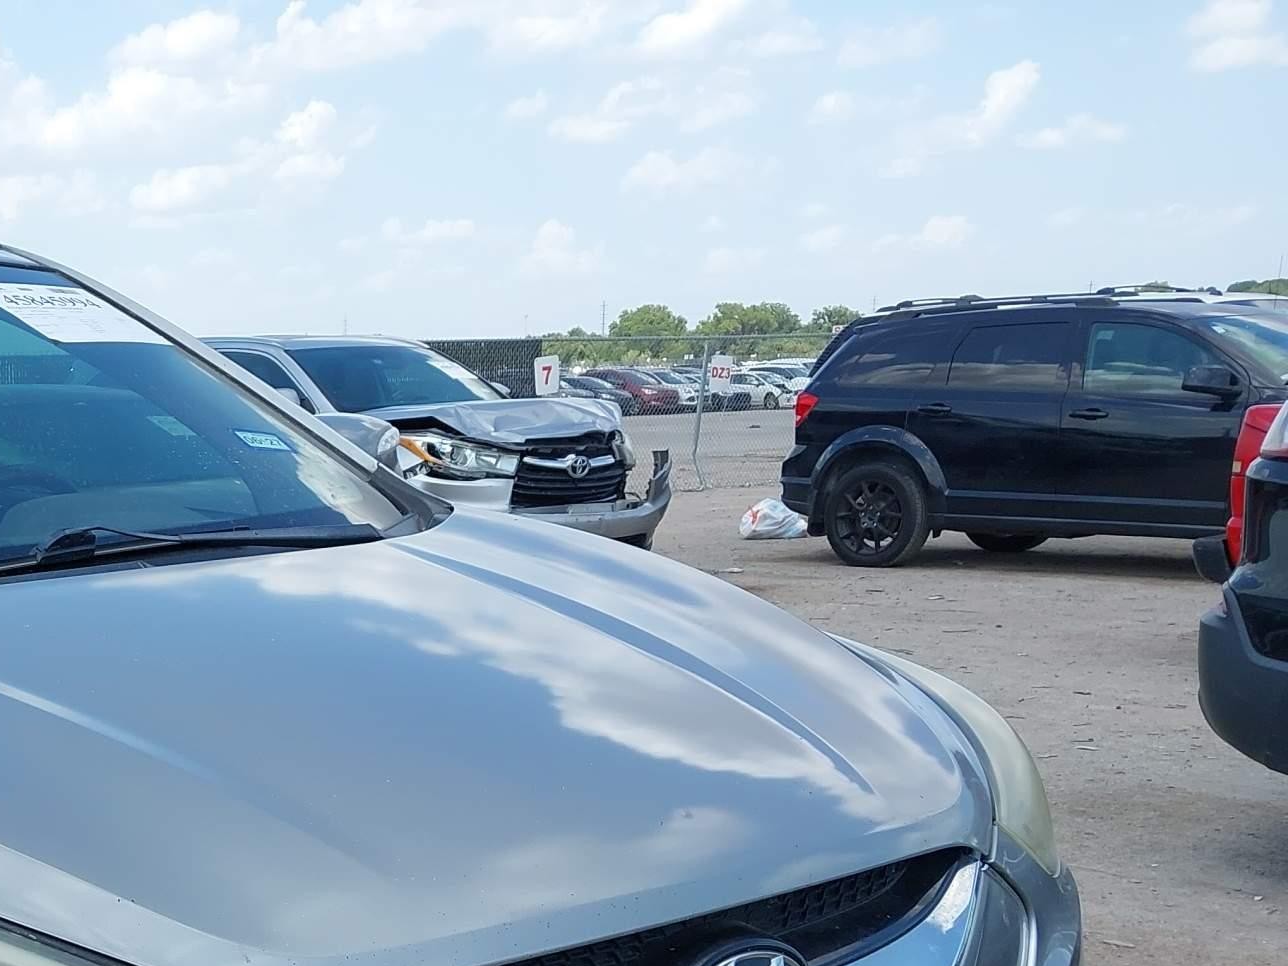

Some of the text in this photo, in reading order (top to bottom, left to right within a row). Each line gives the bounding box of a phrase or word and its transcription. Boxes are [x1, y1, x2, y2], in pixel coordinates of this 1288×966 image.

[3, 294, 103, 309] 45845994
[541, 365, 553, 386] 7
[711, 366, 731, 379] DZ3
